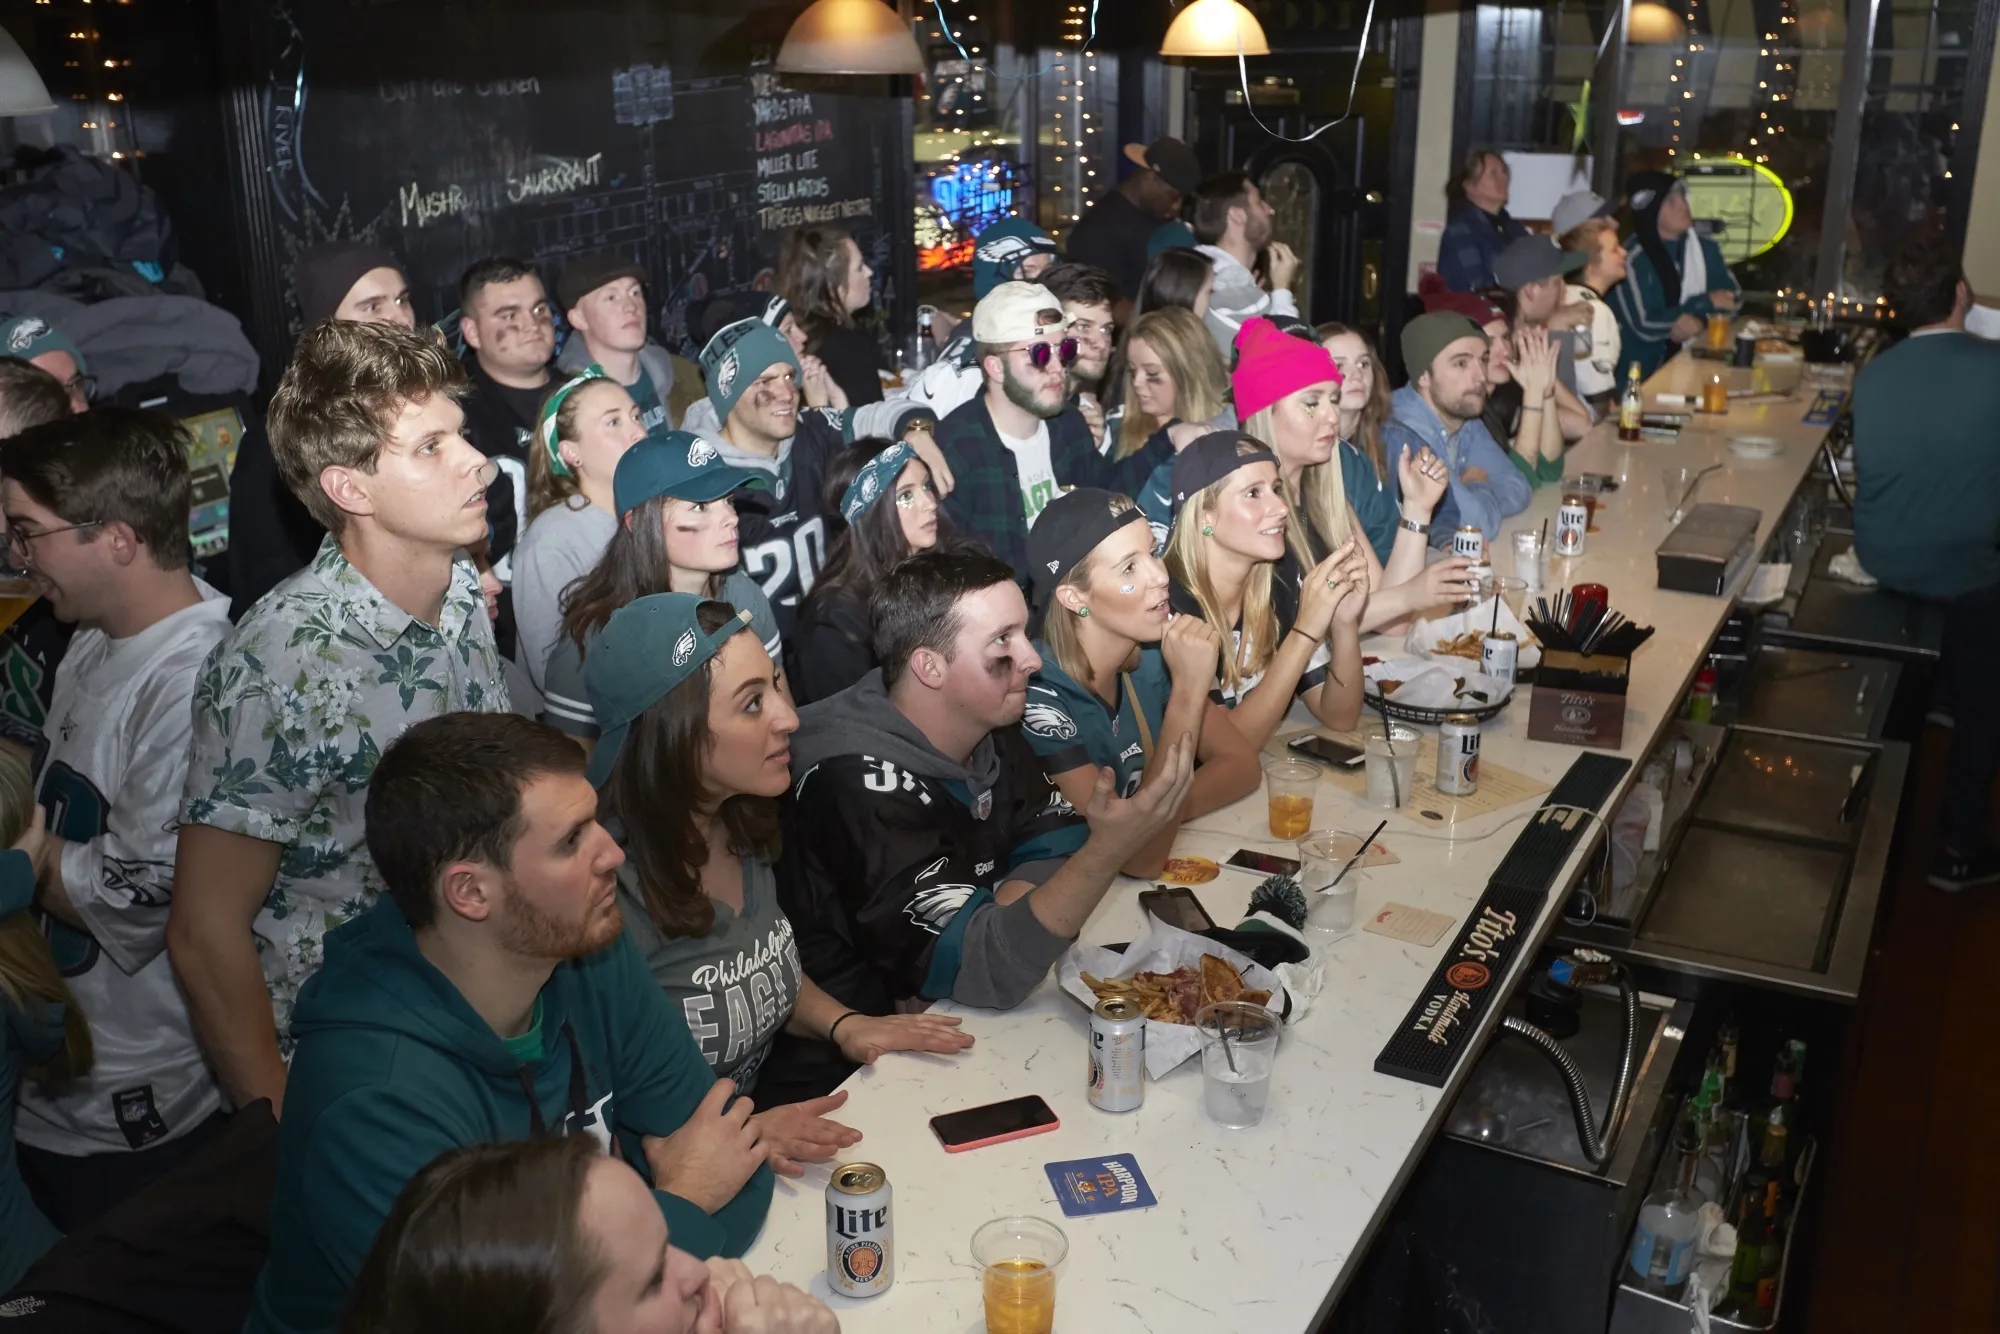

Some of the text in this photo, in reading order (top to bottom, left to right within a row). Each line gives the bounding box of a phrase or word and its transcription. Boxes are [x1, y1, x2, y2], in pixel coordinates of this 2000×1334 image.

[743, 515, 826, 606] 20
[1454, 537, 1480, 554] Lite
[1413, 994, 1448, 1031] VODKA
[1427, 990, 1471, 1046] Handmade
[1095, 1172, 1120, 1198] IPA
[1101, 1160, 1139, 1204] HARPOON
[834, 1203, 888, 1240] Lite
